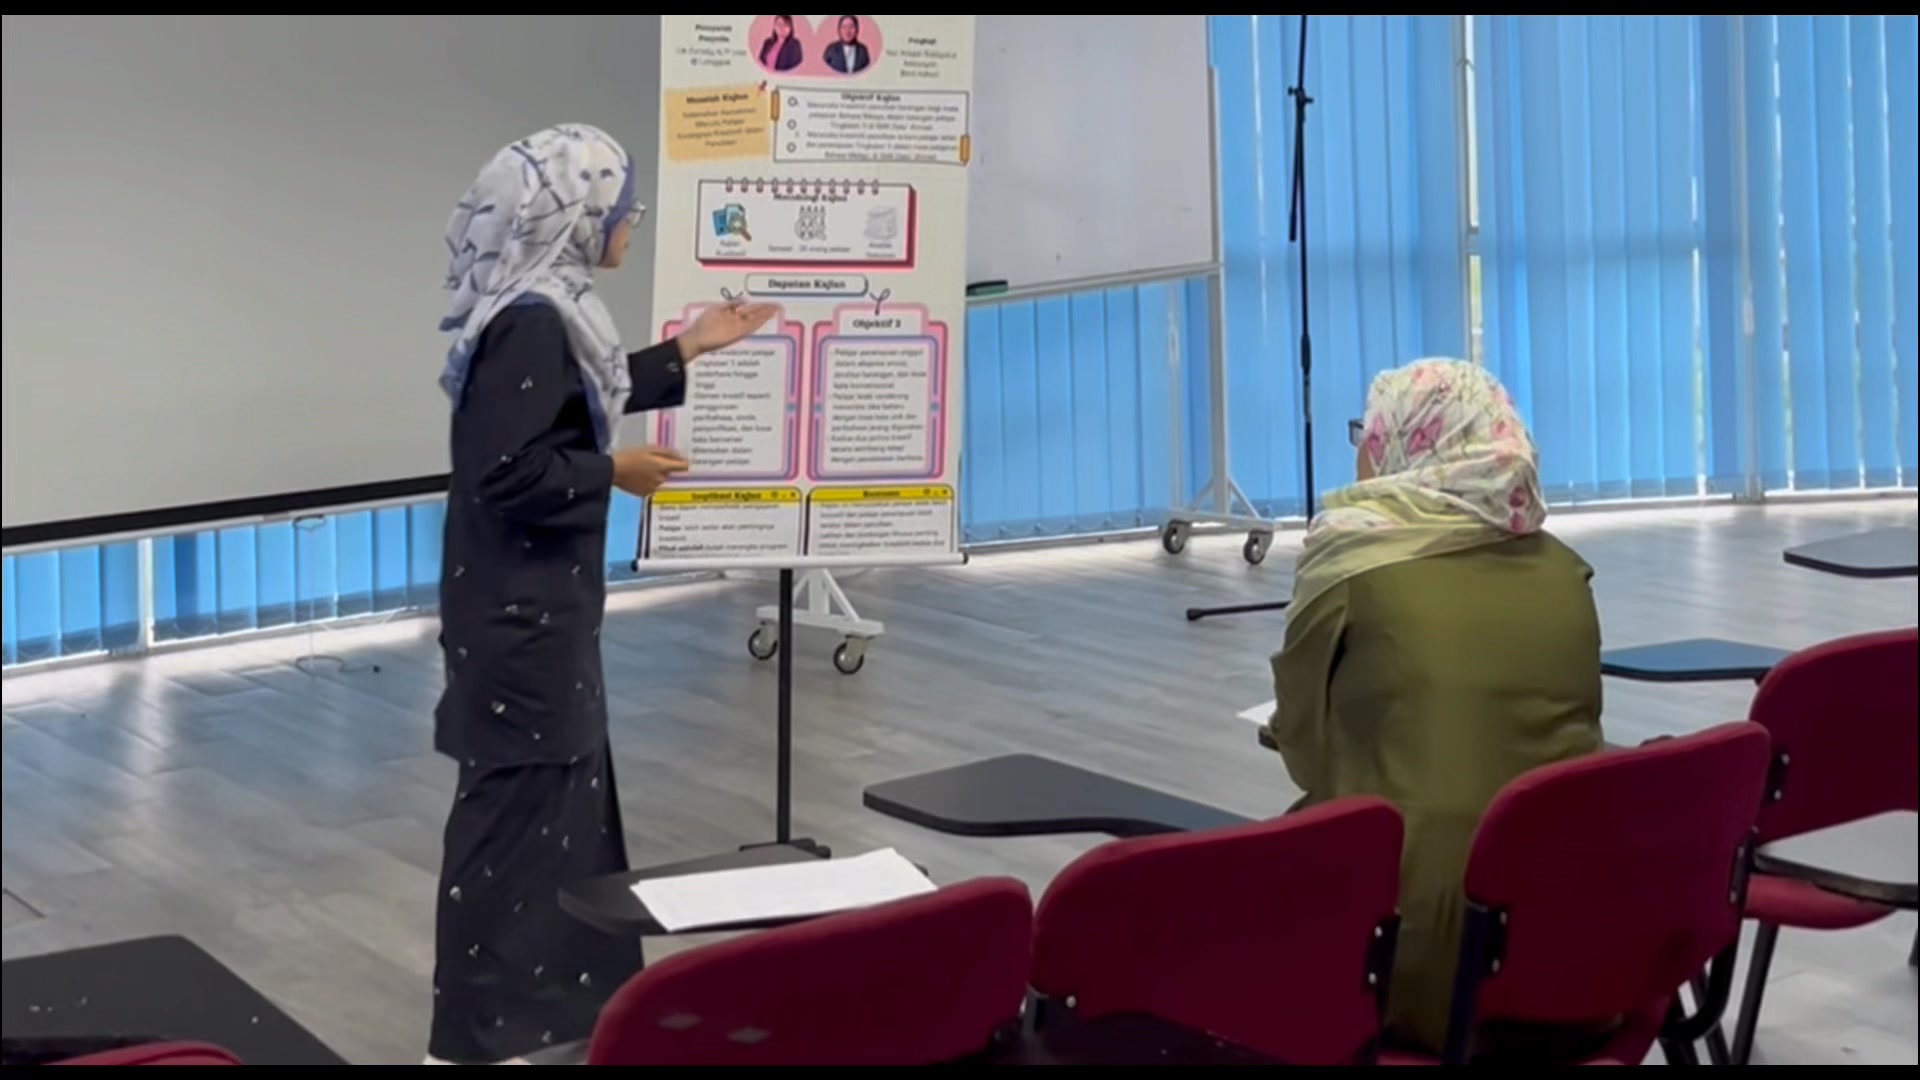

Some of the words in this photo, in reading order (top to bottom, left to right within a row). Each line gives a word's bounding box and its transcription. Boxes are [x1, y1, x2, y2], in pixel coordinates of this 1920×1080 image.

[768, 280, 812, 290] Dapatan
[814, 280, 846, 290] Kajian
[852, 318, 892, 330] Objektif
